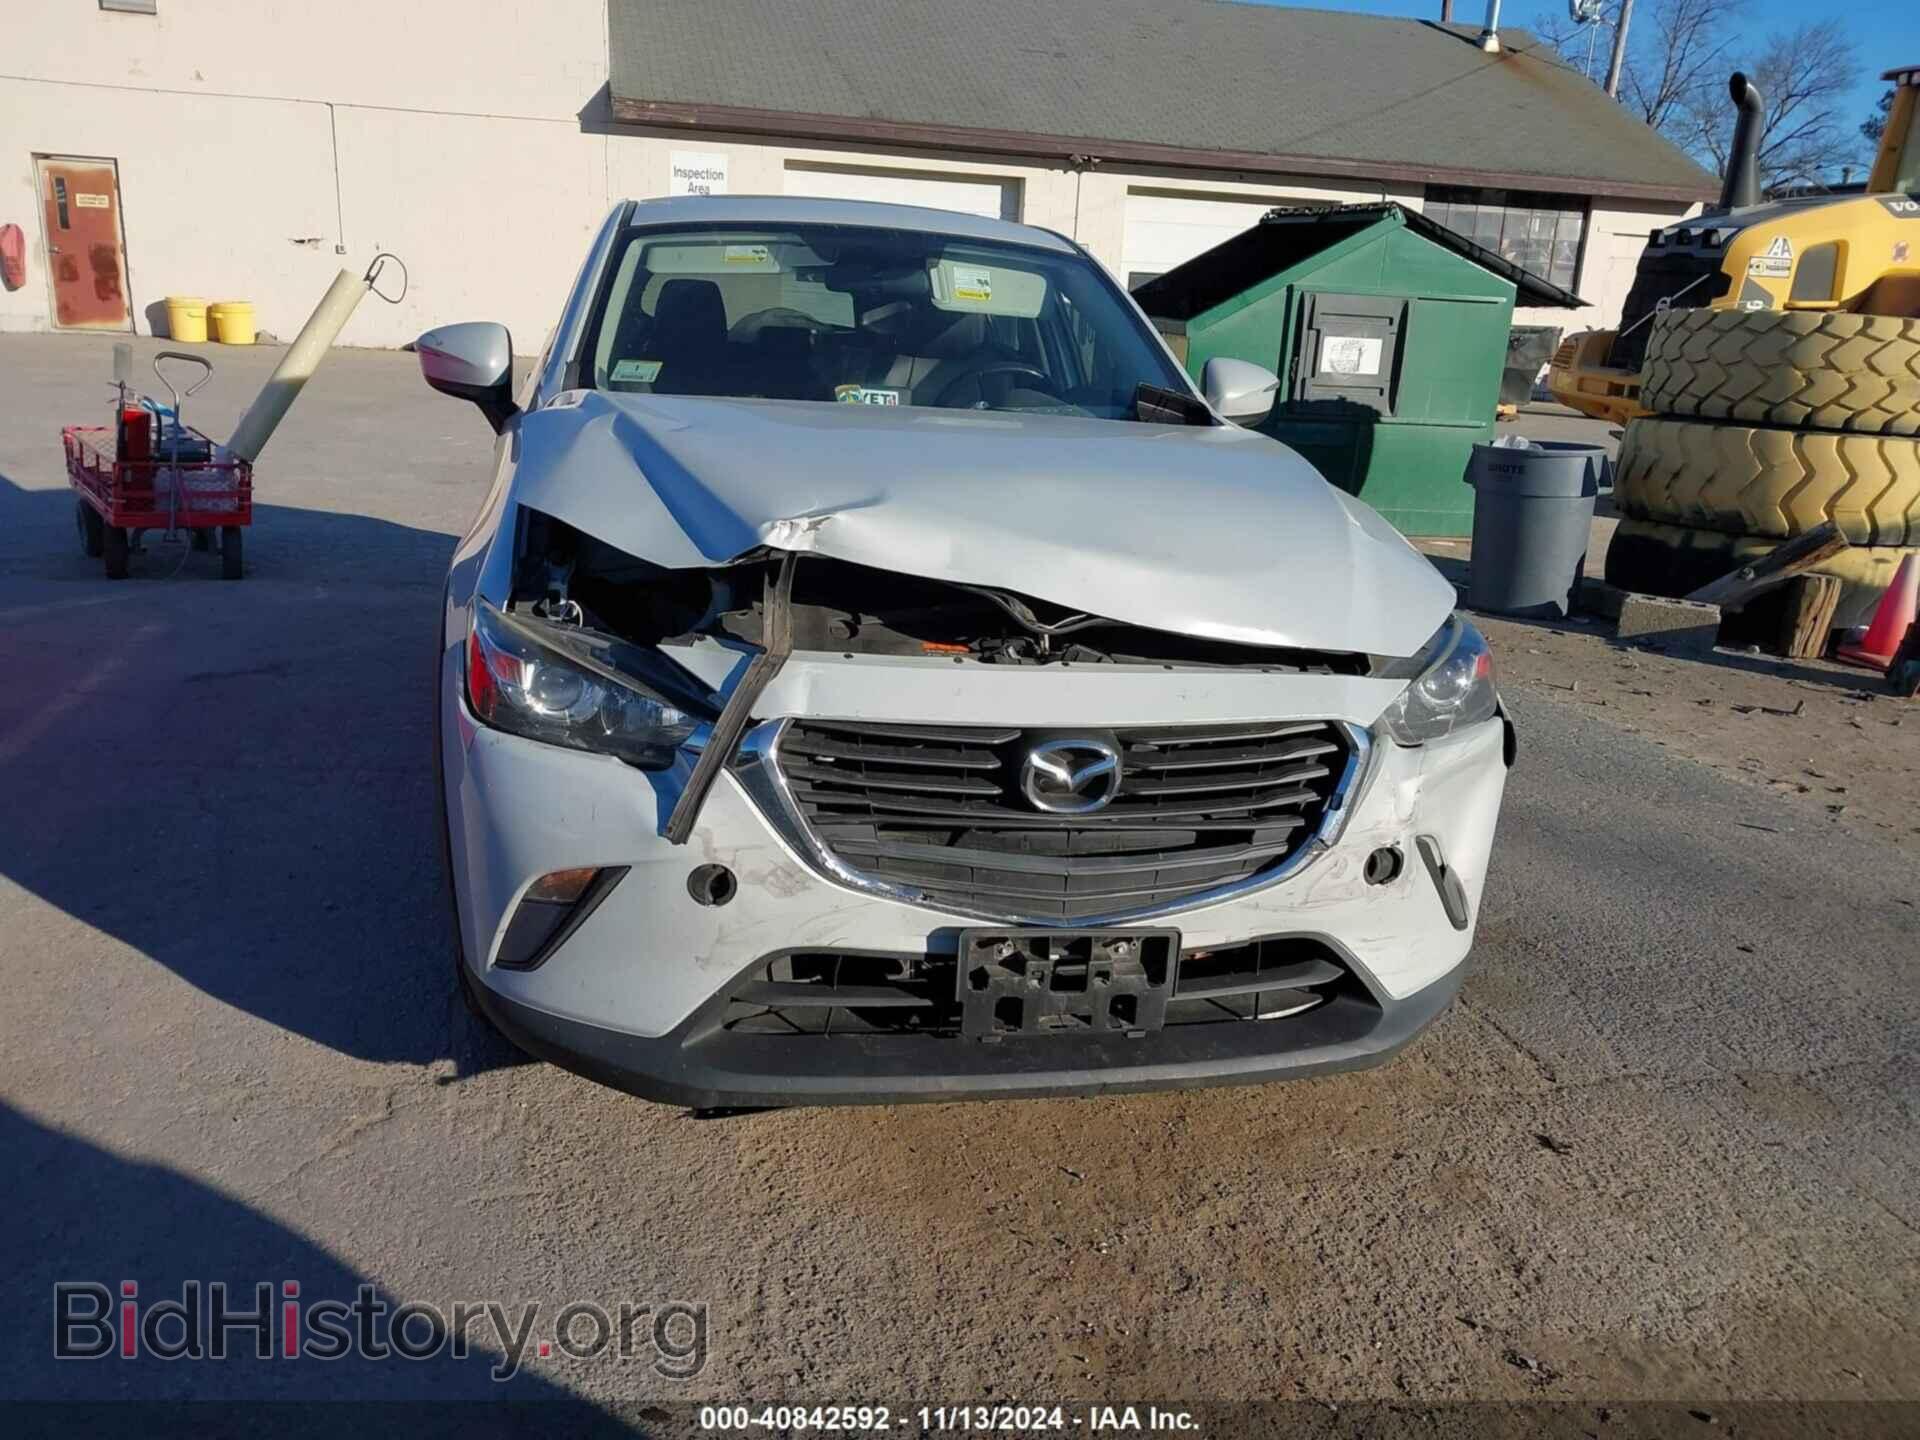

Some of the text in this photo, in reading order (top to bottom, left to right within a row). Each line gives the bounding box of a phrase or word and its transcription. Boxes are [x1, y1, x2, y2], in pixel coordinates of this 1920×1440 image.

[673, 165, 724, 180] Inspection
[688, 181, 711, 195] Area
[1888, 201, 1919, 212] VO
